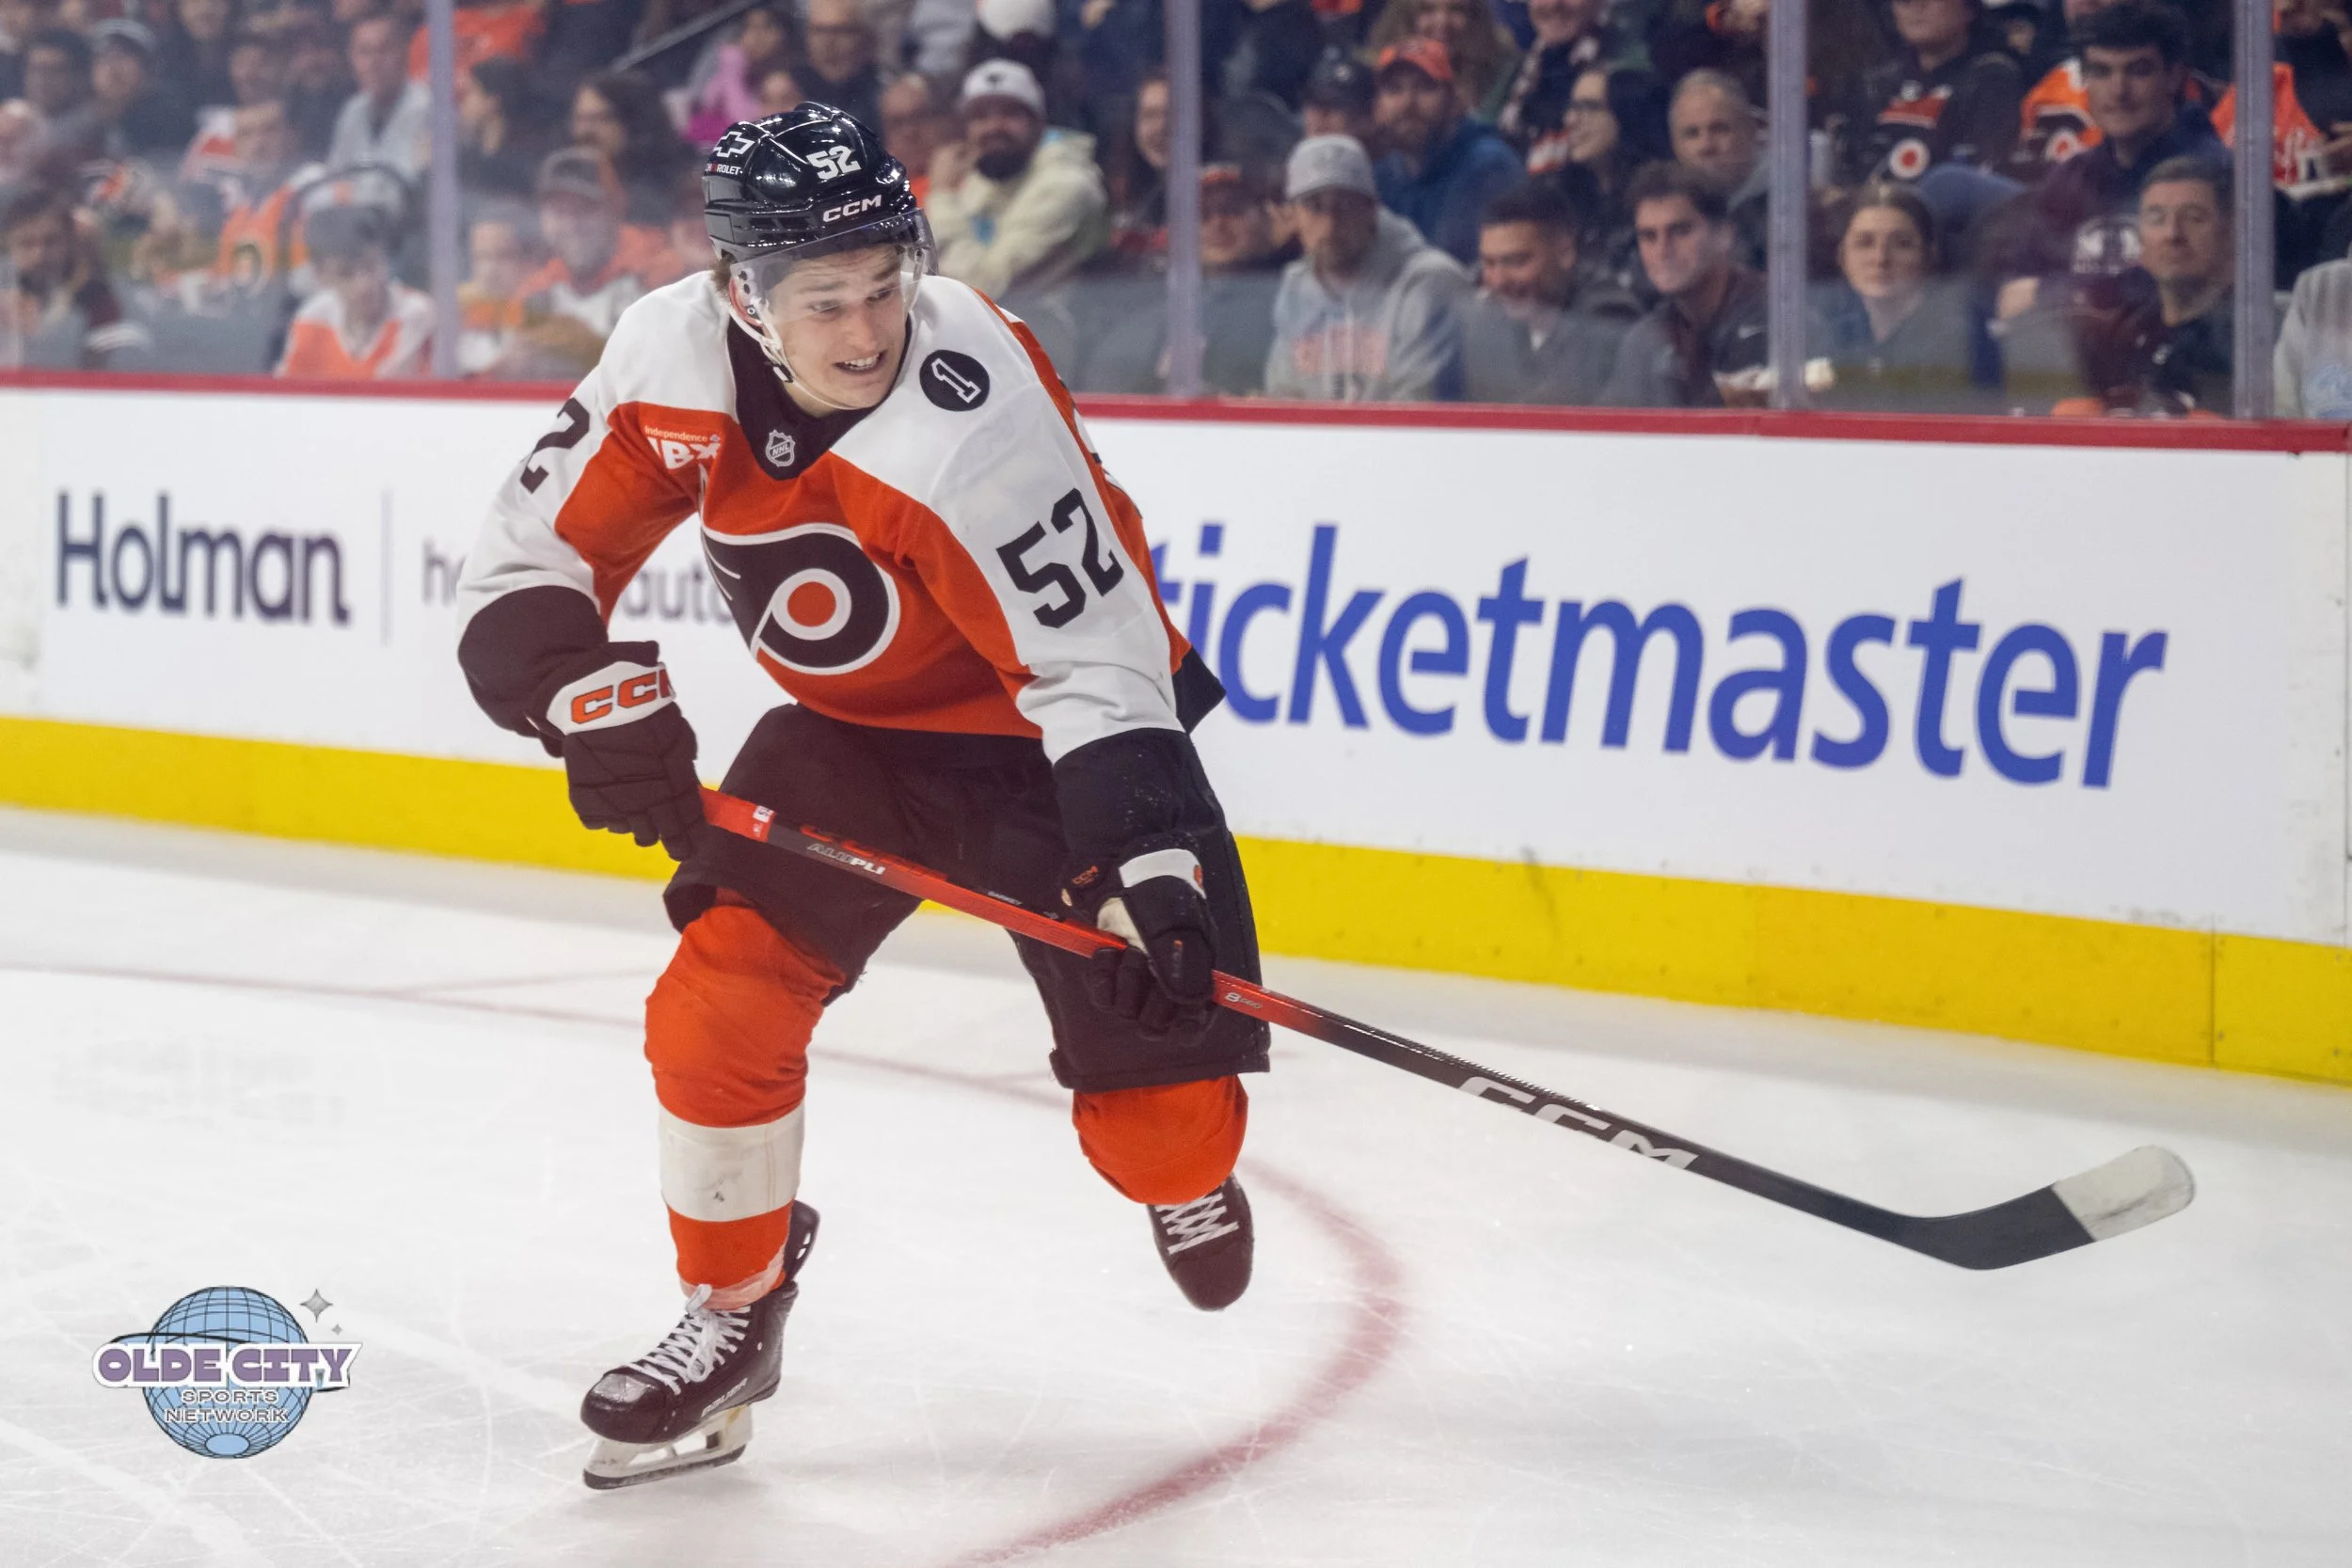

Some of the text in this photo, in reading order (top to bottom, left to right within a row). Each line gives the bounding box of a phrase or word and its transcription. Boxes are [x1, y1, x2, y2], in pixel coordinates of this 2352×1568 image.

[806, 145, 862, 180] 52
[822, 194, 882, 223] CCM
[644, 425, 708, 443] Independence
[772, 443, 790, 456] NHL
[56, 490, 351, 629] Holman
[995, 487, 1124, 629] 52
[1459, 1076, 1699, 1170] CCM
